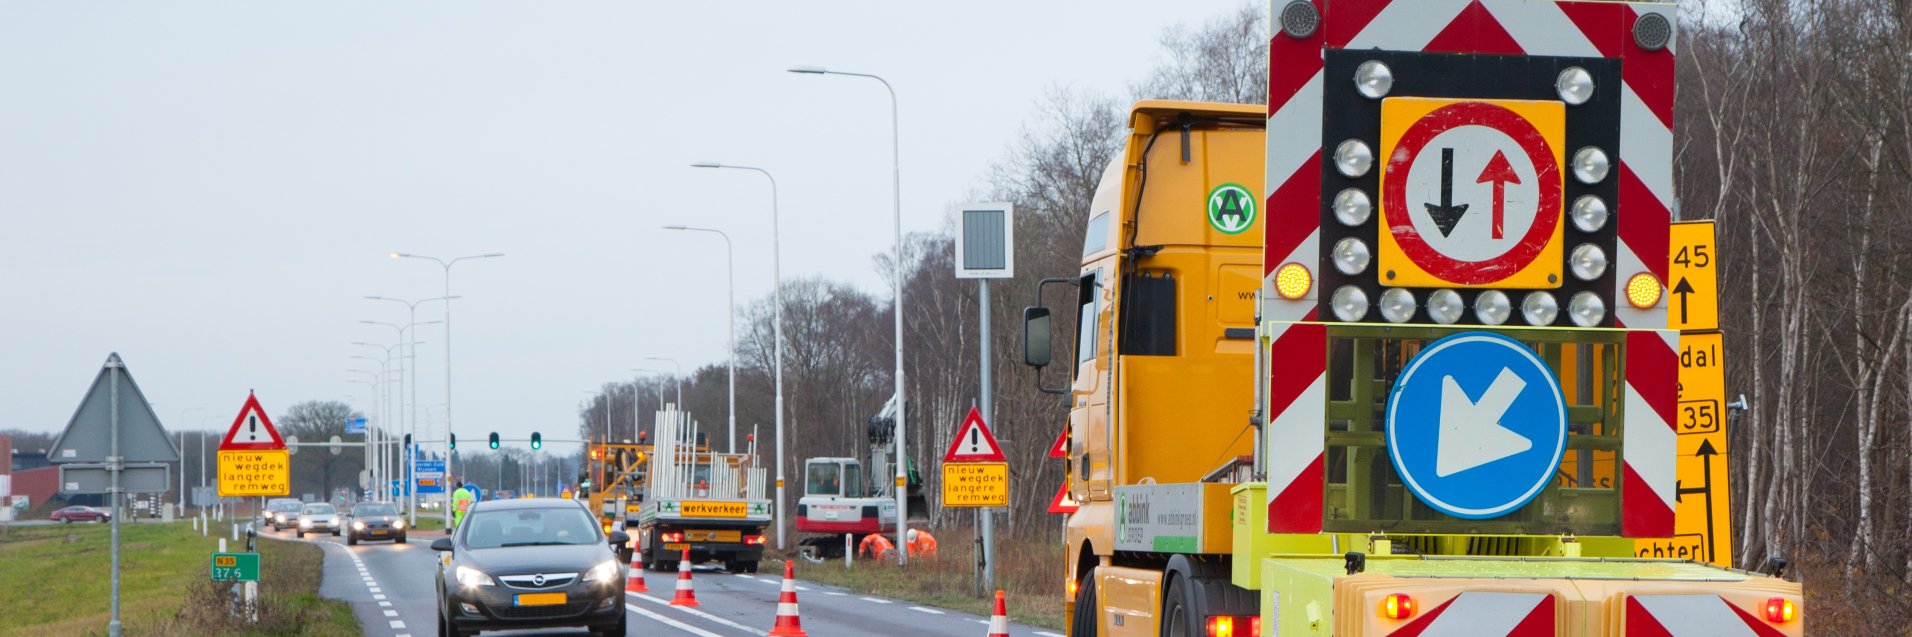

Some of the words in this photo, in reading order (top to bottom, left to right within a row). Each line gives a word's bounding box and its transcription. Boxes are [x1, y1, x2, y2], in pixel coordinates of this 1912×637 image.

[1673, 245, 1710, 269] 45
[1683, 405, 1714, 430] 35
[223, 452, 263, 462] nieuw
[235, 462, 284, 472] wegdek
[948, 465, 985, 474] nieuw
[223, 473, 275, 483] langere
[960, 474, 1004, 484] wegdek
[233, 483, 285, 493] remweg
[948, 484, 995, 493] langere
[957, 494, 1005, 504] remweg
[683, 503, 746, 513] werkverkeer
[1128, 493, 1150, 525] abbink
[1635, 541, 1700, 559] chter
